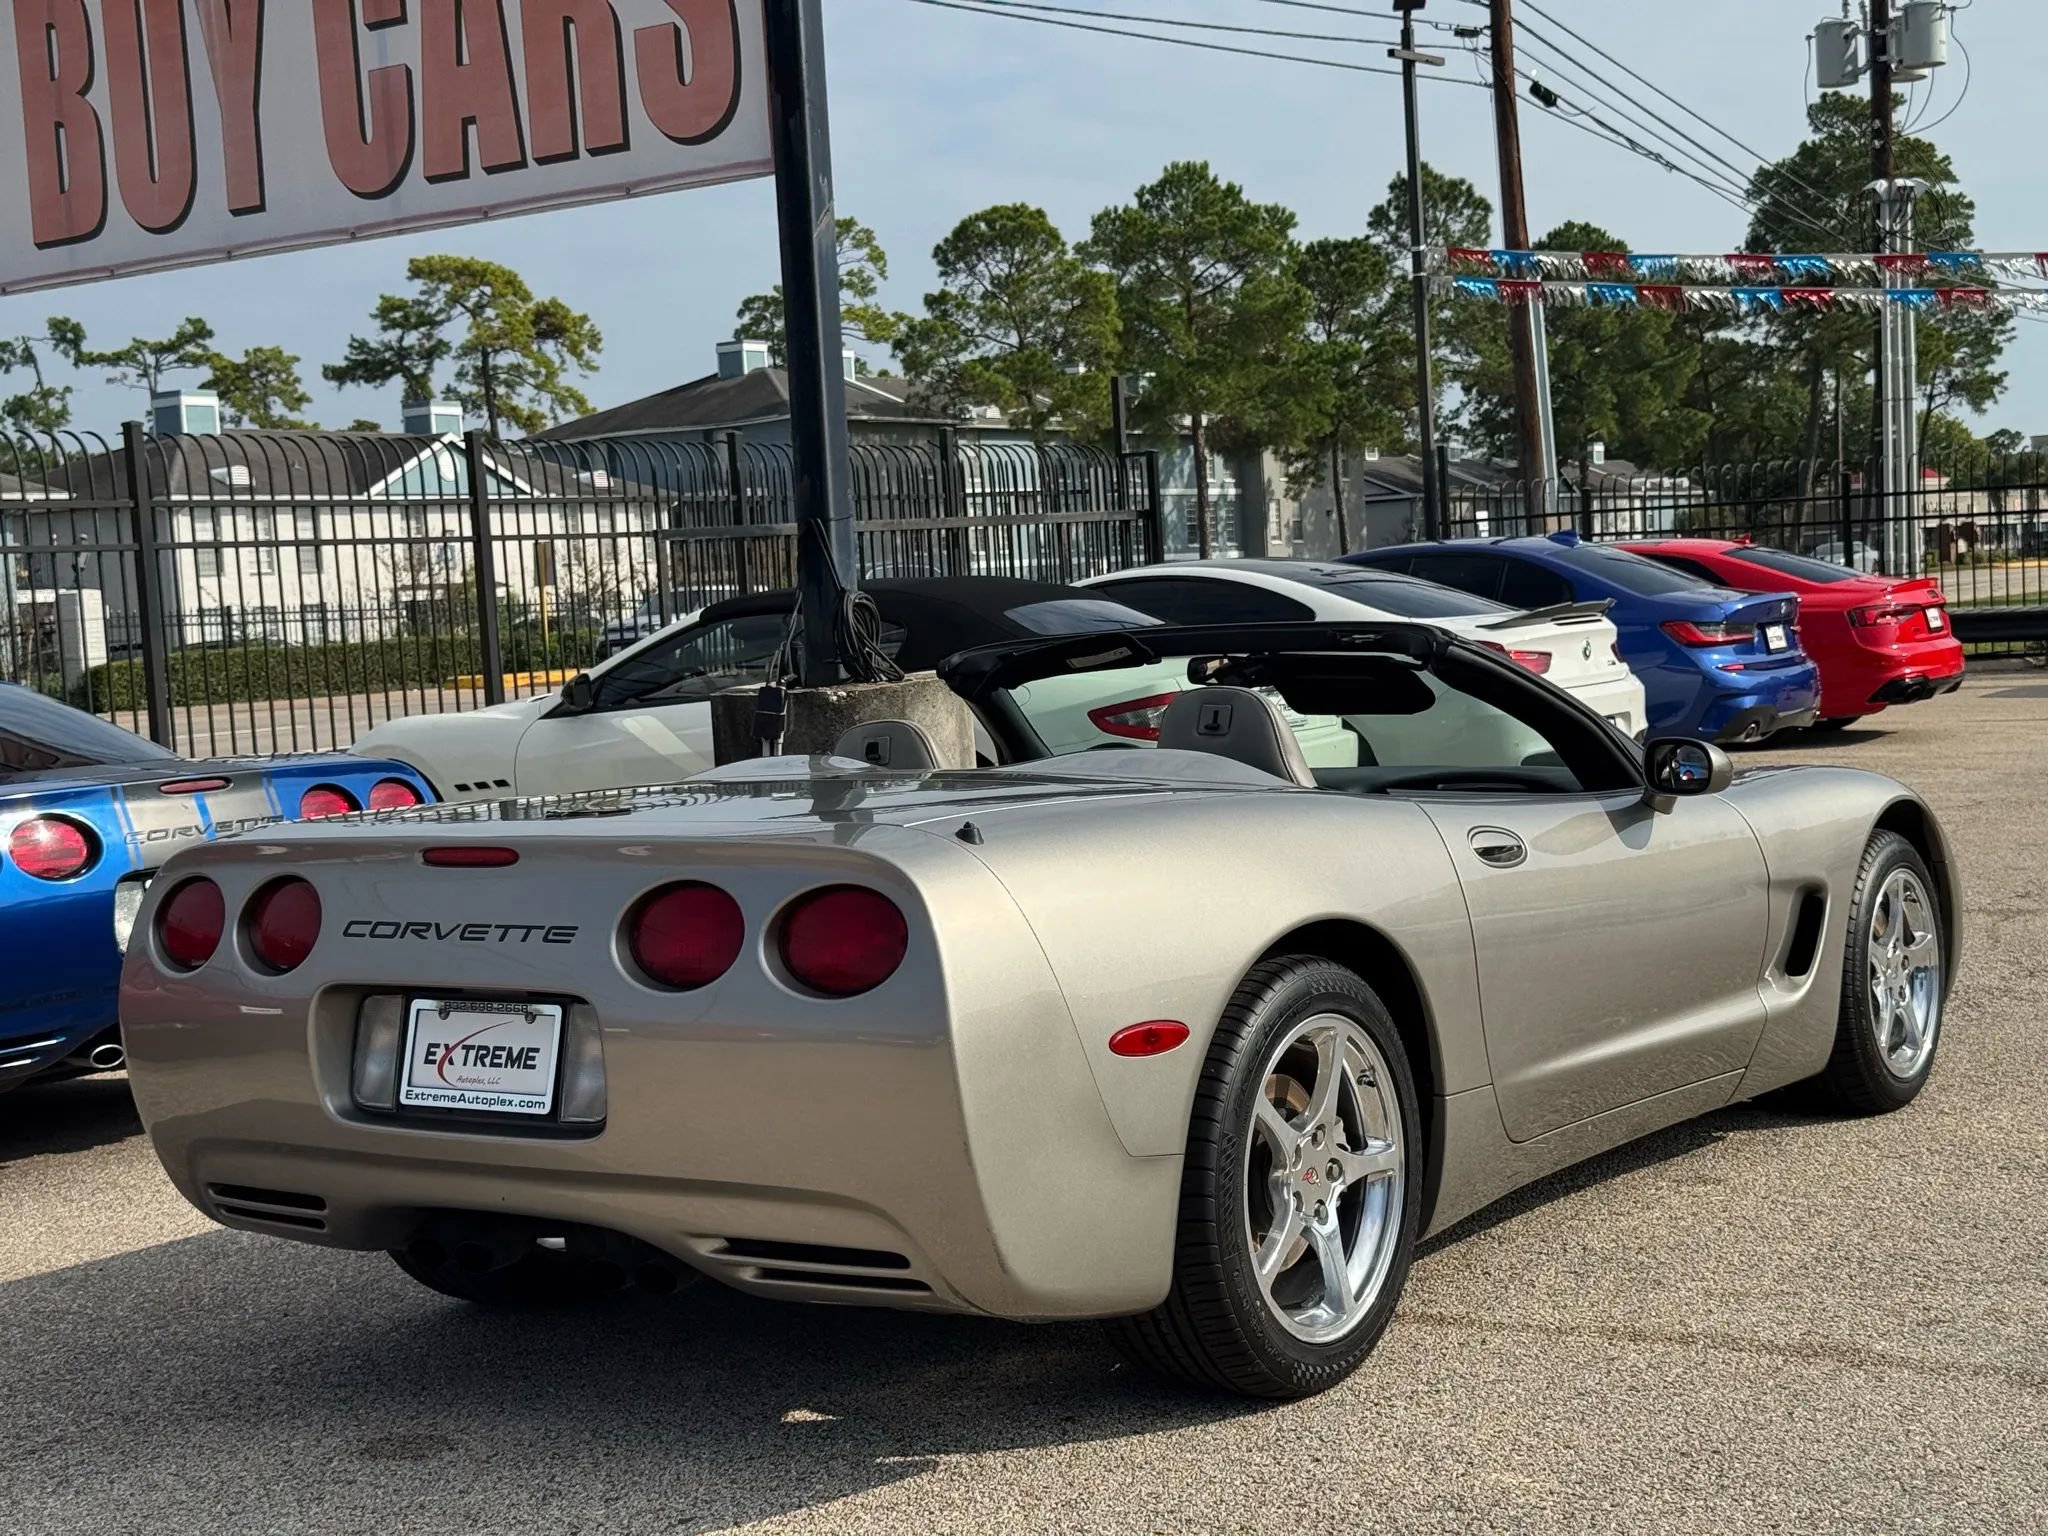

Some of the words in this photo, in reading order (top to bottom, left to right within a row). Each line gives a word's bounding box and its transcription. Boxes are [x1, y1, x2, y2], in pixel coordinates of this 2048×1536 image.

[13, 0, 267, 249] BUY
[342, 920, 579, 944] CORVETTE
[423, 1043, 541, 1070] EXTREME
[487, 1076, 502, 1085] LLC
[405, 1090, 546, 1109] ExtremeAutoplex.com
